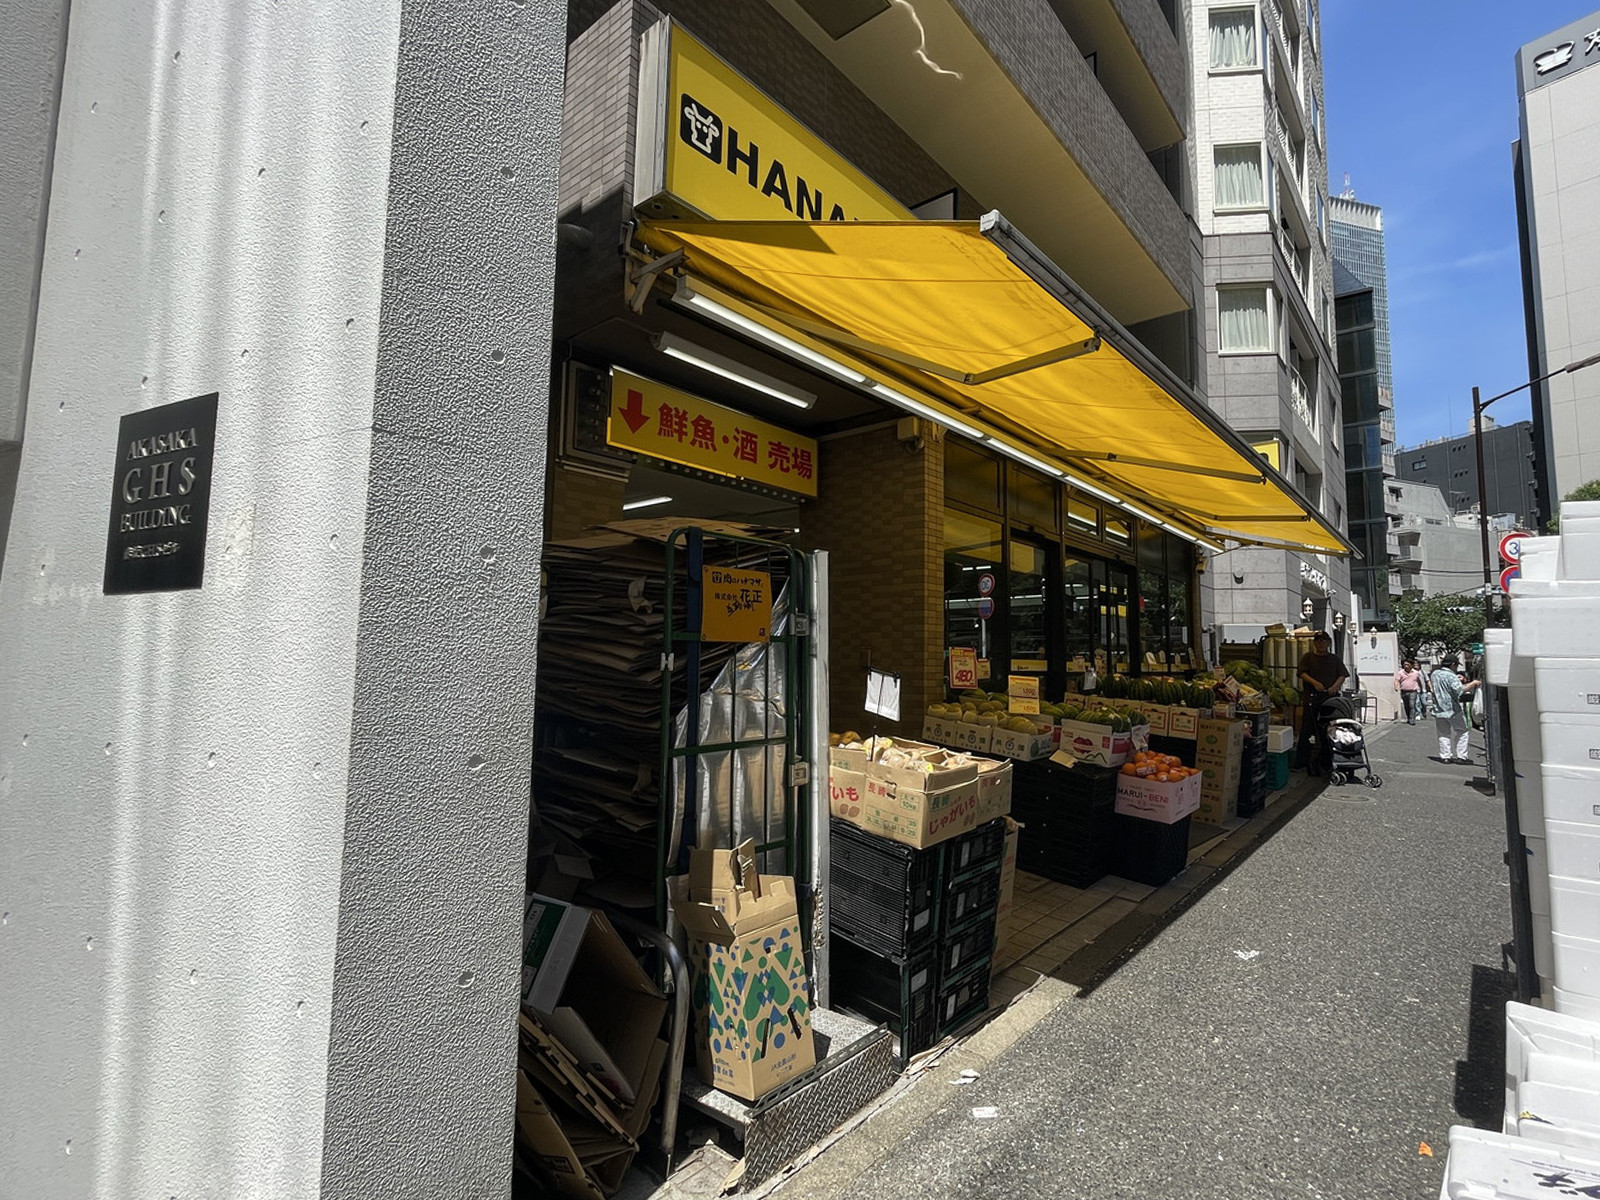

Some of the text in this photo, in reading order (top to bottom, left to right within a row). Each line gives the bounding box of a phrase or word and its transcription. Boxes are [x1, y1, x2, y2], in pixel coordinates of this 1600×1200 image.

[127, 427, 199, 461] AKASAKA
[120, 504, 193, 533] BUILDING
[955, 670, 973, 683] 480
